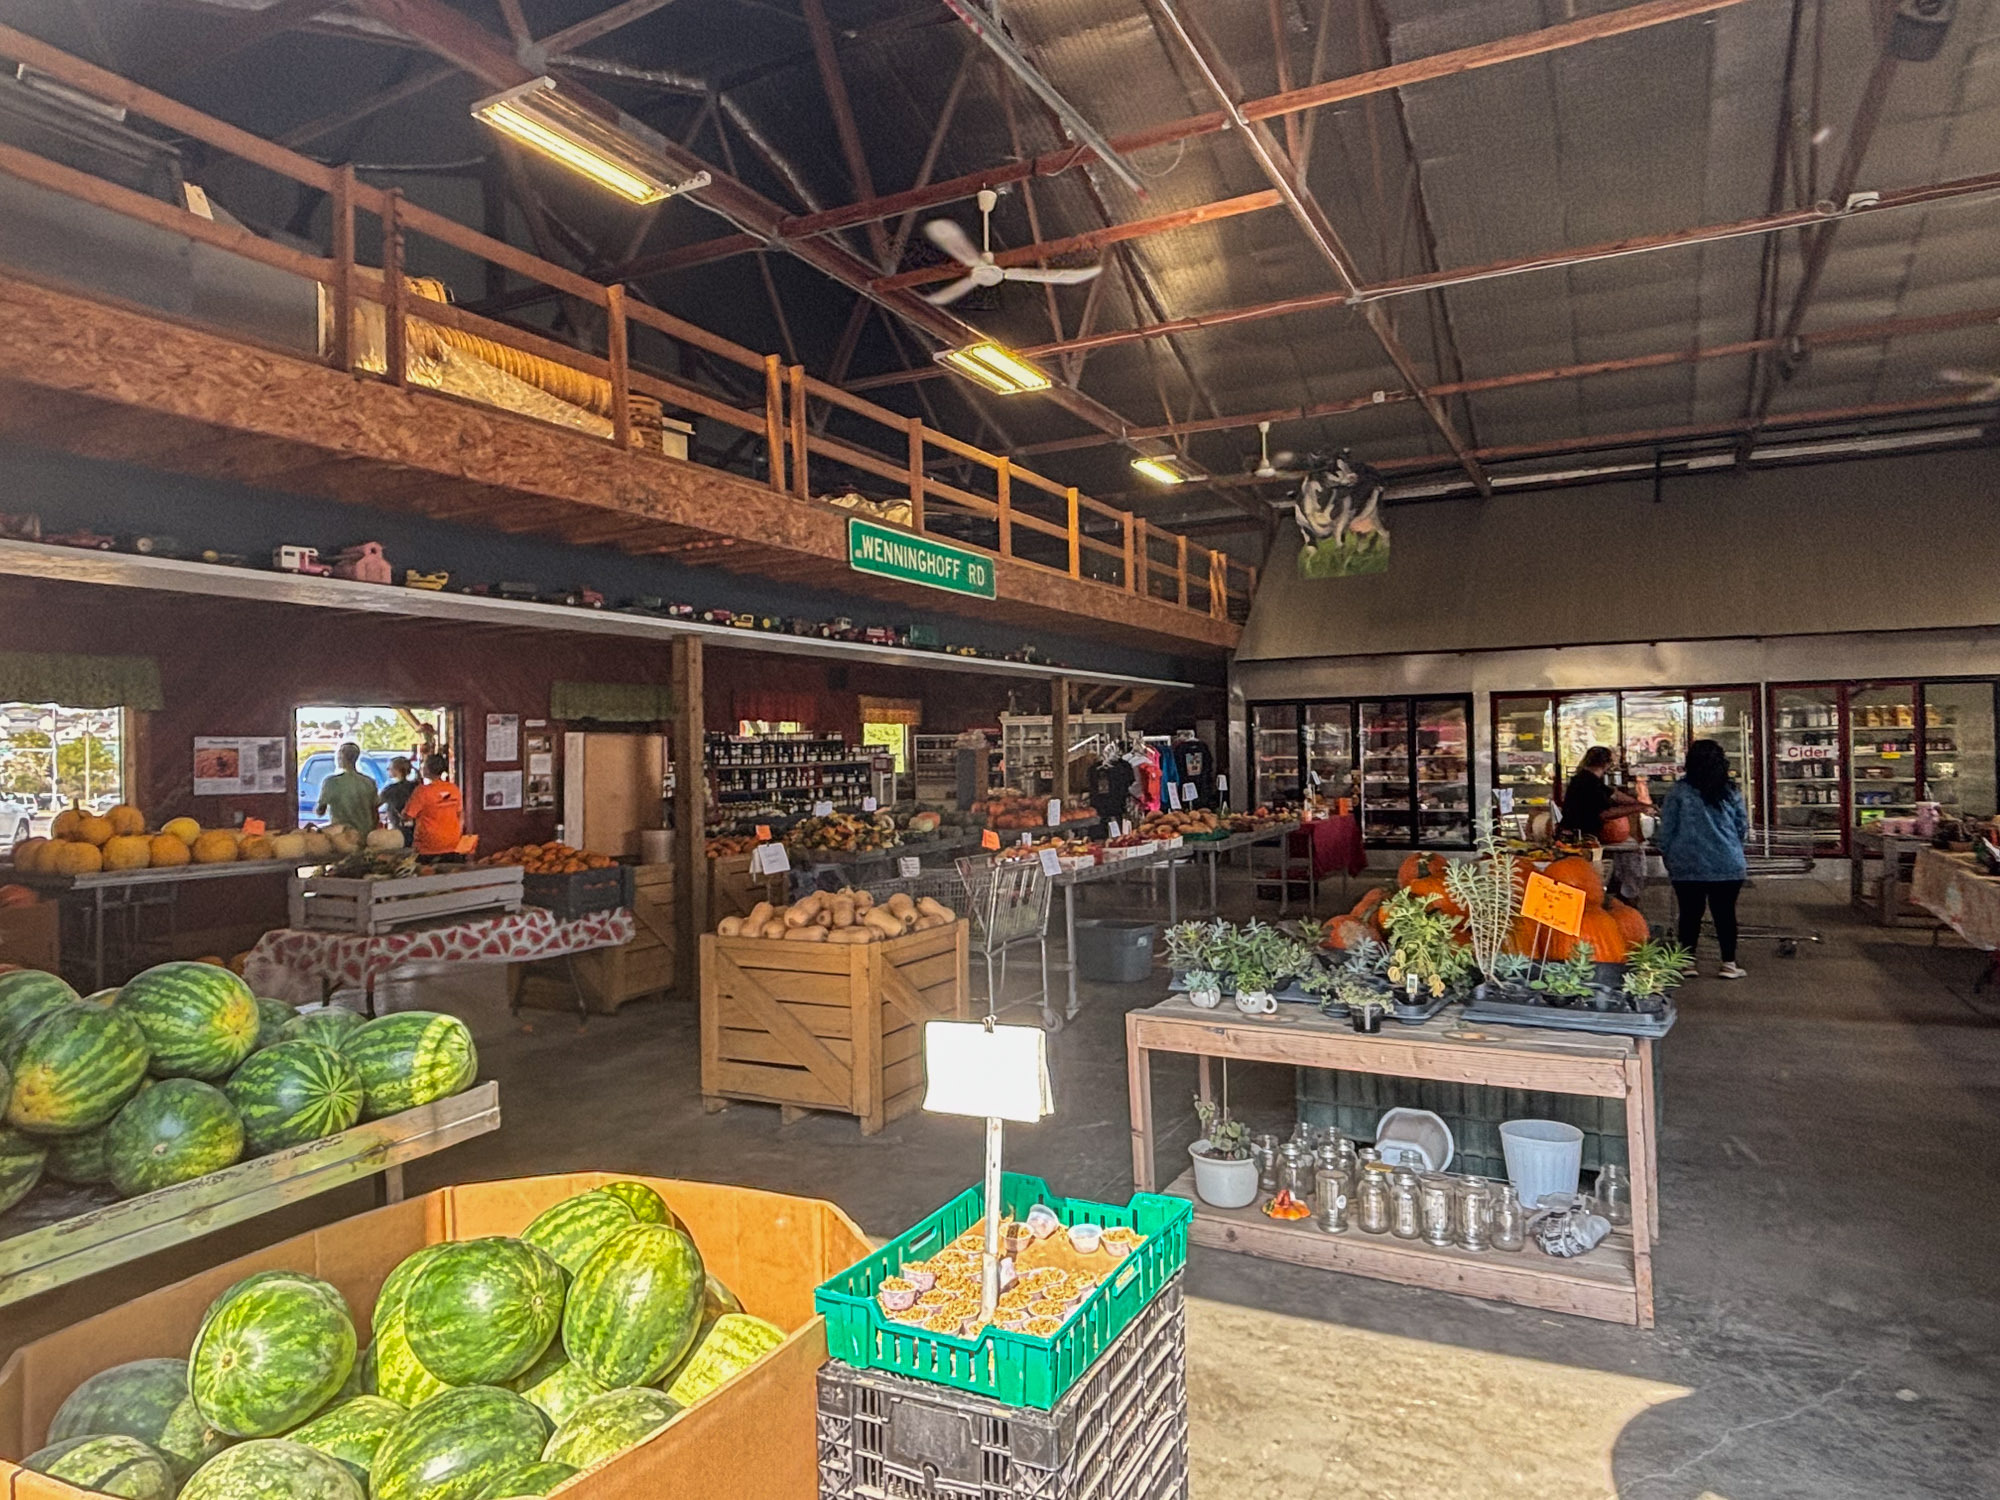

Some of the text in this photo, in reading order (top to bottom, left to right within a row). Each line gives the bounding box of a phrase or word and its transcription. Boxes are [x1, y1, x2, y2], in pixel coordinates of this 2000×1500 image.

[862, 534, 985, 587] WENNINGHOFF RD
[1788, 747, 1830, 758] Cider
[1634, 764, 1685, 775] eese
